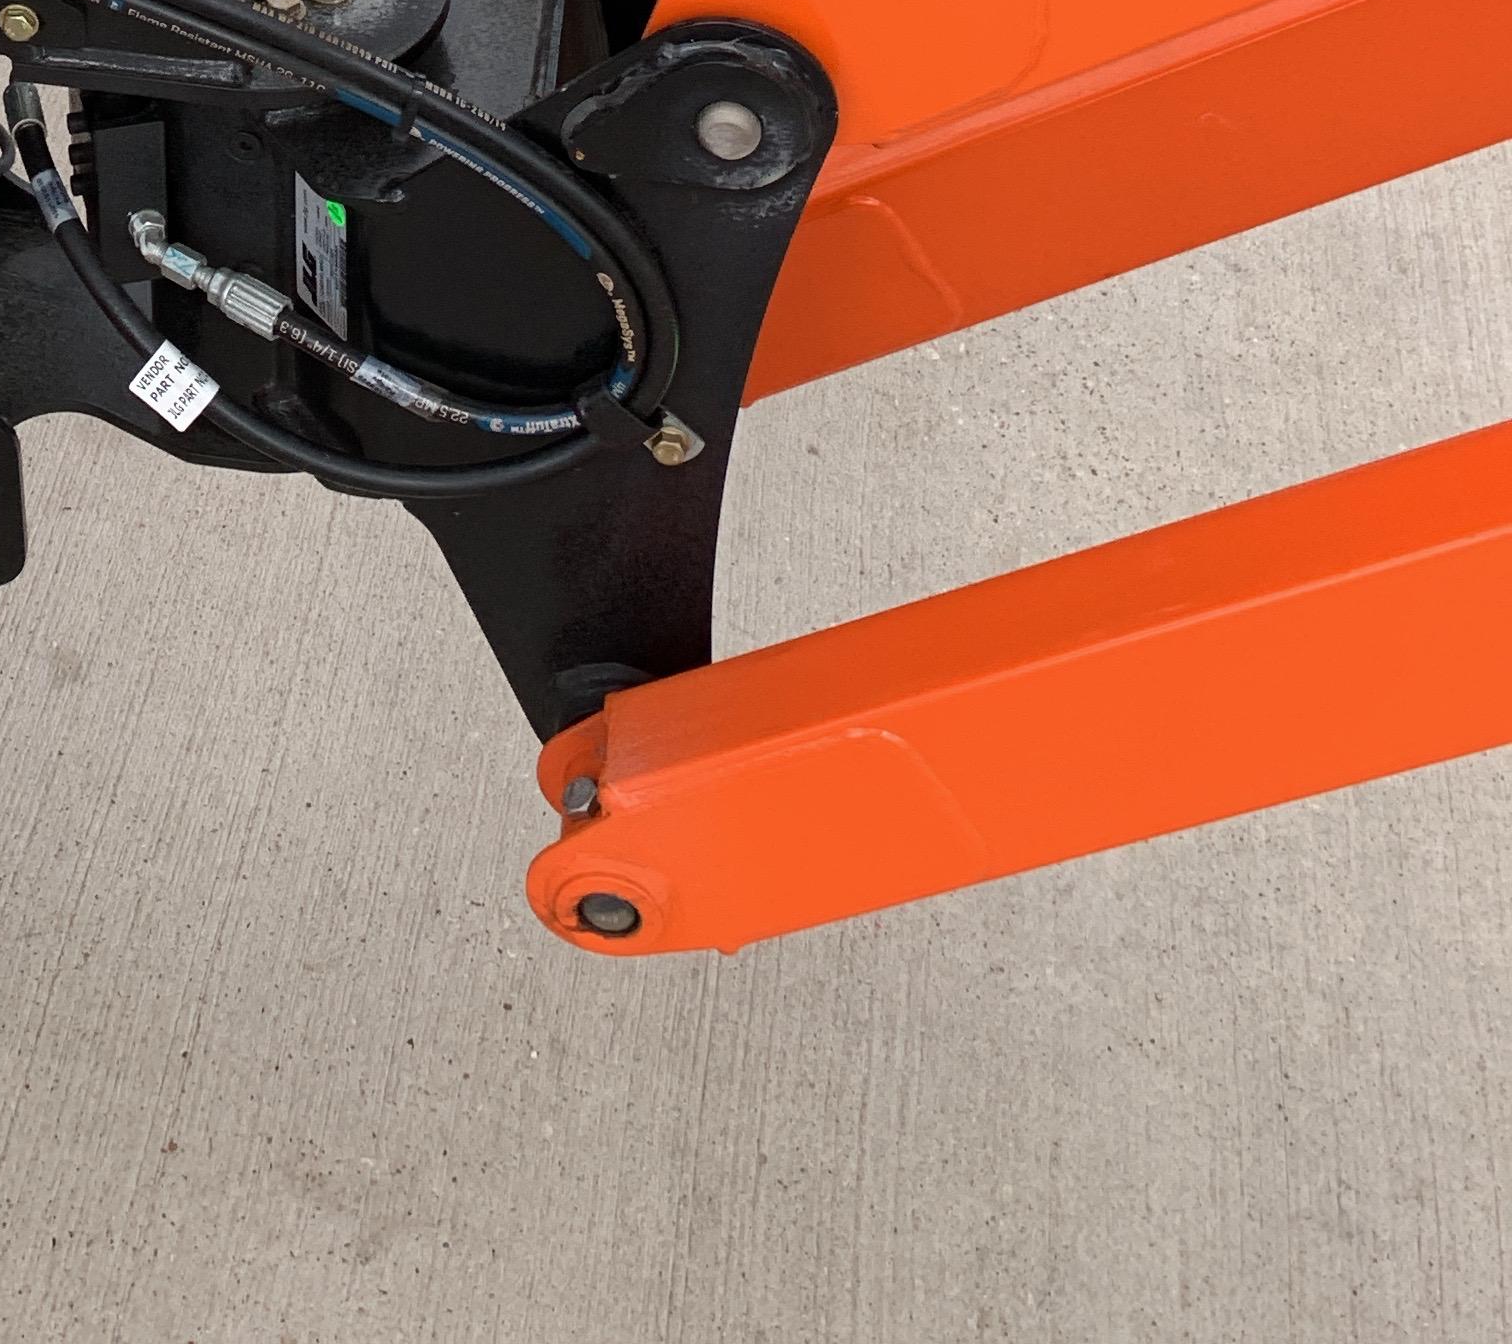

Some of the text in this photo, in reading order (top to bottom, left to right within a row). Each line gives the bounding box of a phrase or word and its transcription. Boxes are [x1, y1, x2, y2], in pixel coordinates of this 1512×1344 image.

[127, 7, 169, 32] Flame
[169, 23, 233, 55] Resistant
[428, 137, 485, 175] POWERING
[301, 238, 319, 309] JLG
[136, 354, 170, 390] VENDOR
[150, 374, 175, 402] PART
[167, 401, 185, 419] JLG
[178, 383, 200, 407] PART
[439, 405, 470, 426] 22.5
